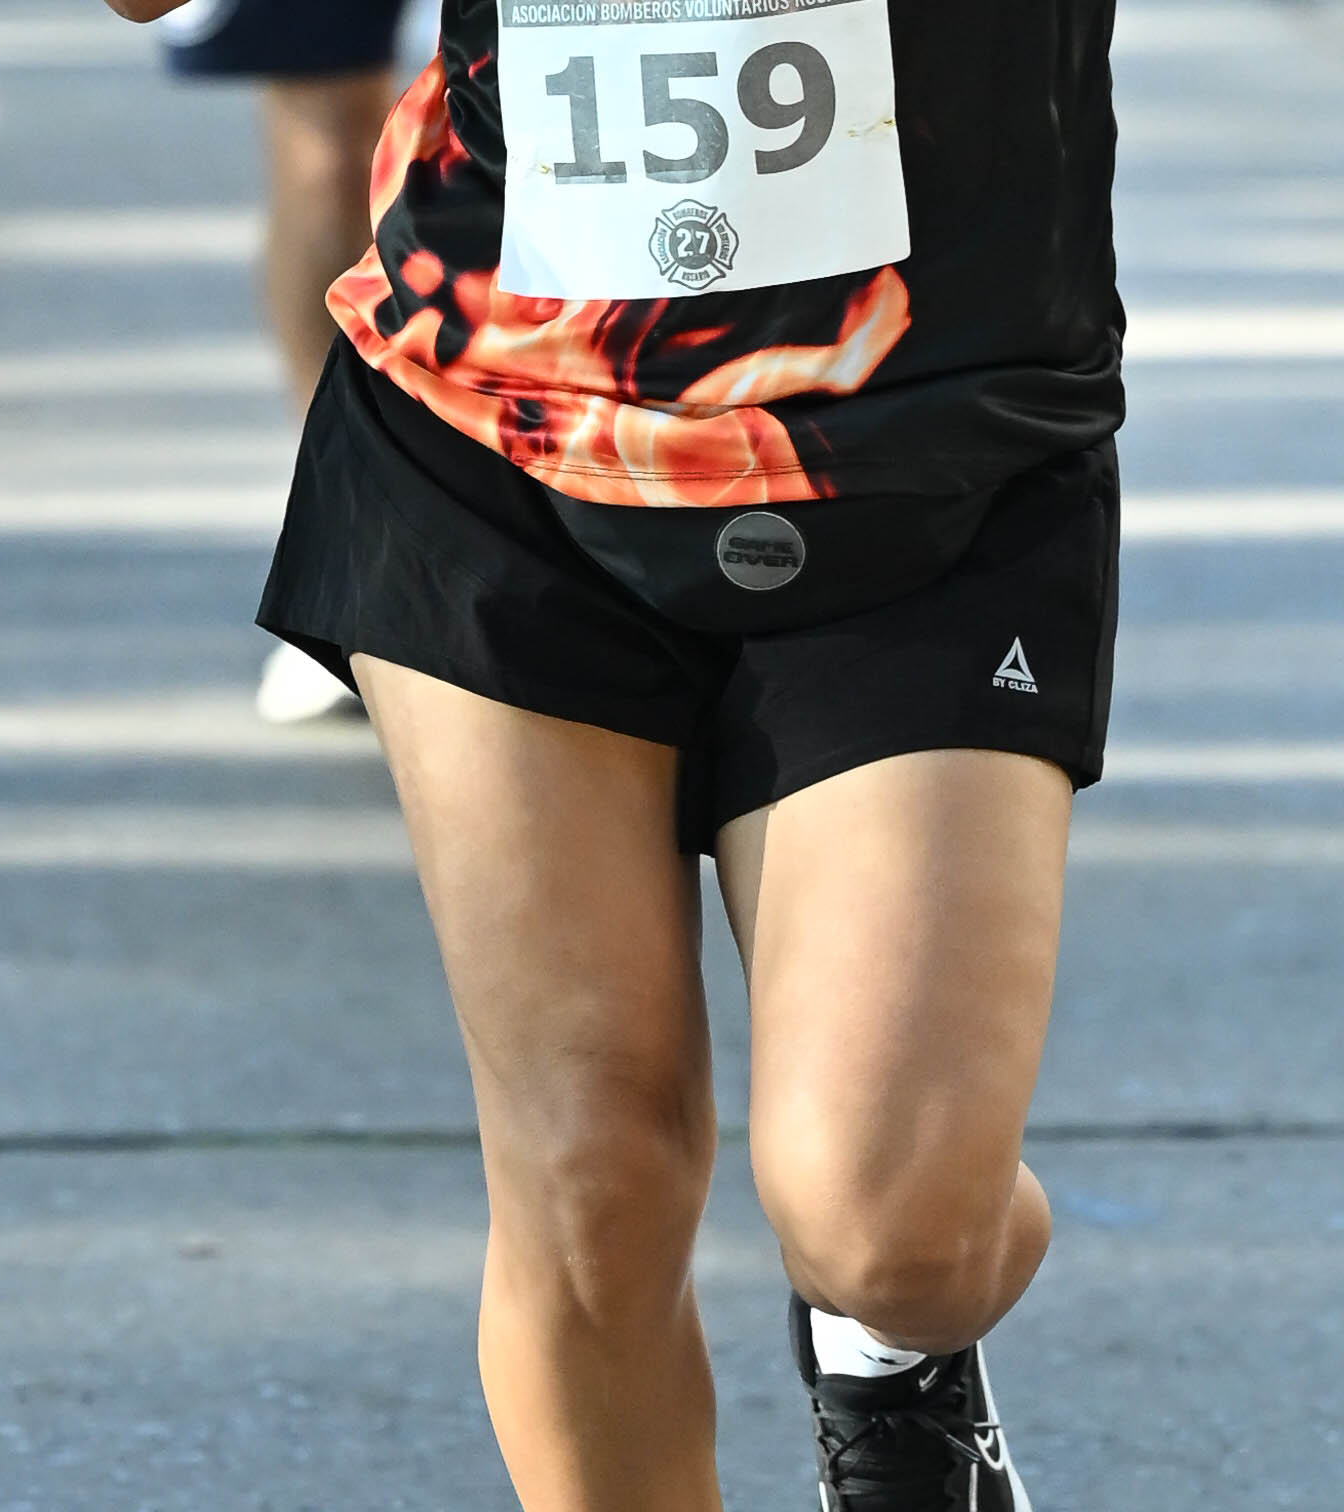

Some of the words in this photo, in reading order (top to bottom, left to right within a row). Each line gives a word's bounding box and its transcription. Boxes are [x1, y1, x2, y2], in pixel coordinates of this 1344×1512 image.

[512, 0, 597, 24] ASOCIACIÓN
[545, 41, 836, 184] 159
[676, 228, 710, 258] 27
[728, 536, 793, 553] GAME
[723, 551, 799, 568] OVER
[992, 676, 1006, 688] BY
[1008, 680, 1038, 694] CLIZA
